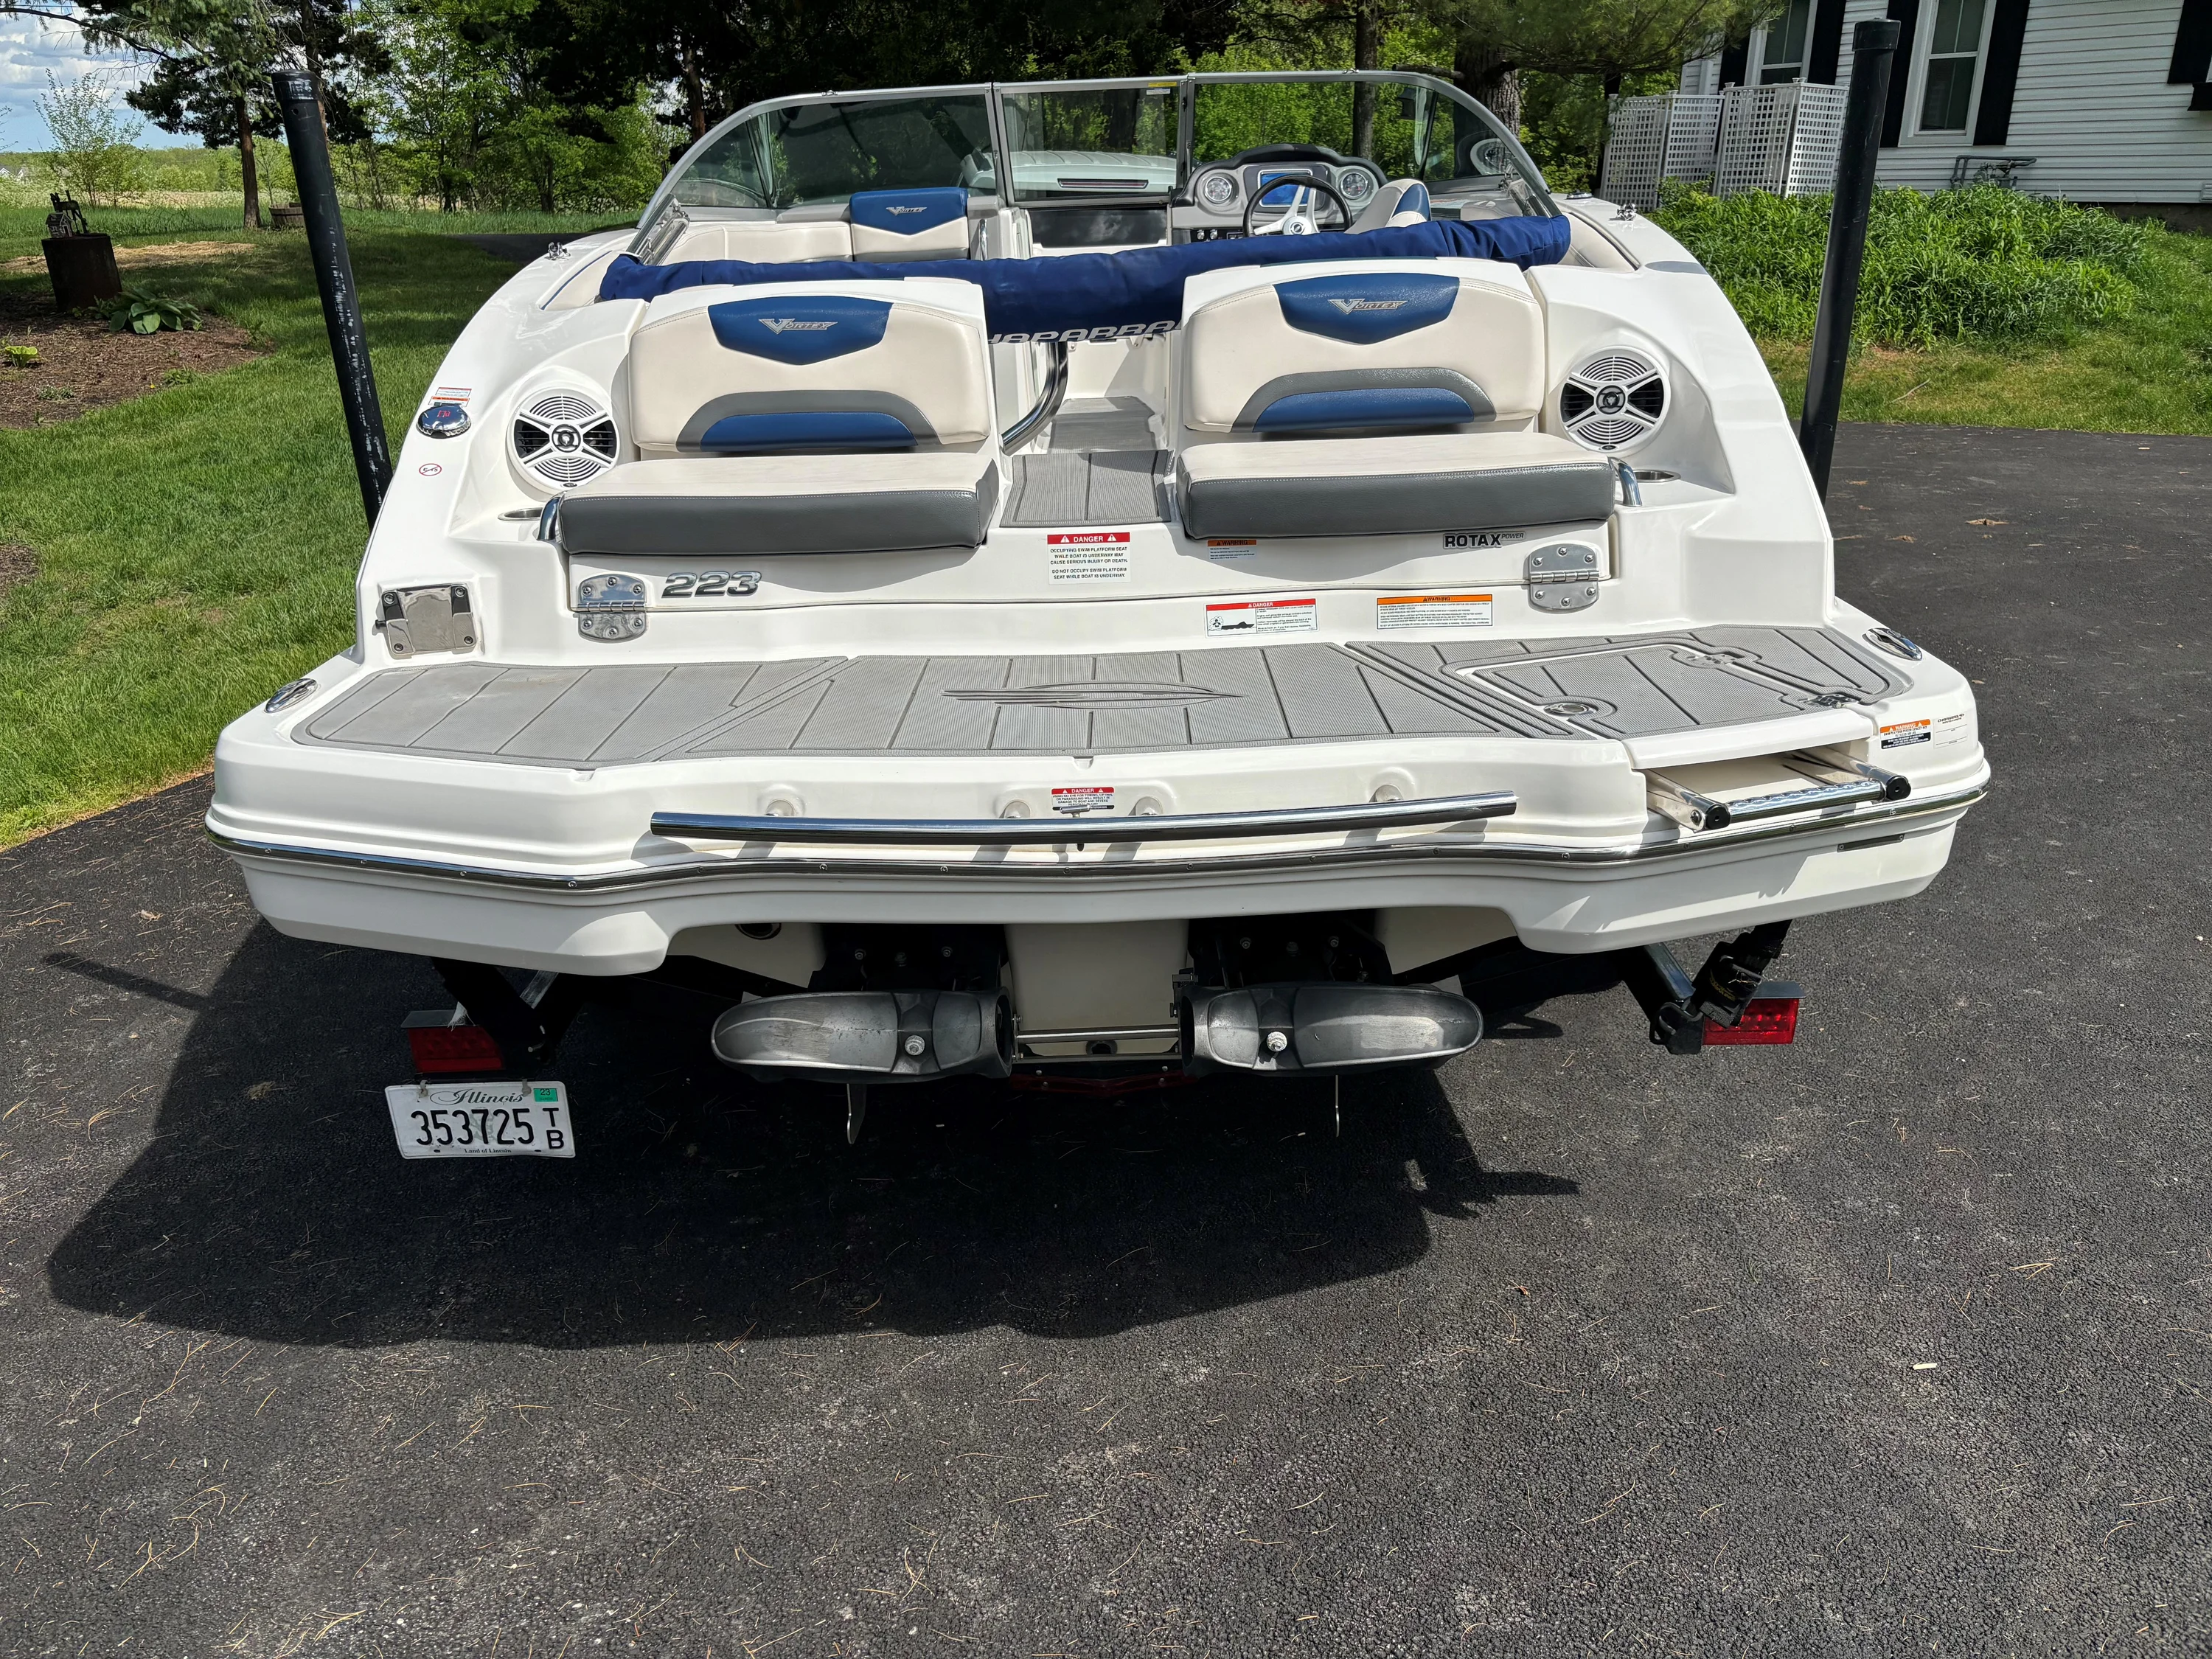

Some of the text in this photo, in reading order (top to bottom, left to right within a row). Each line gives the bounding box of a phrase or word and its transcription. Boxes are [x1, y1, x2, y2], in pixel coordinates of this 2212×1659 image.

[1329, 299, 1405, 314] VORTEX
[759, 319, 834, 334] VORTEX
[1445, 534, 1501, 547] ROTAX
[661, 571, 762, 598] 223
[429, 1088, 523, 1105] Illinois
[411, 1108, 534, 1145] 353725
